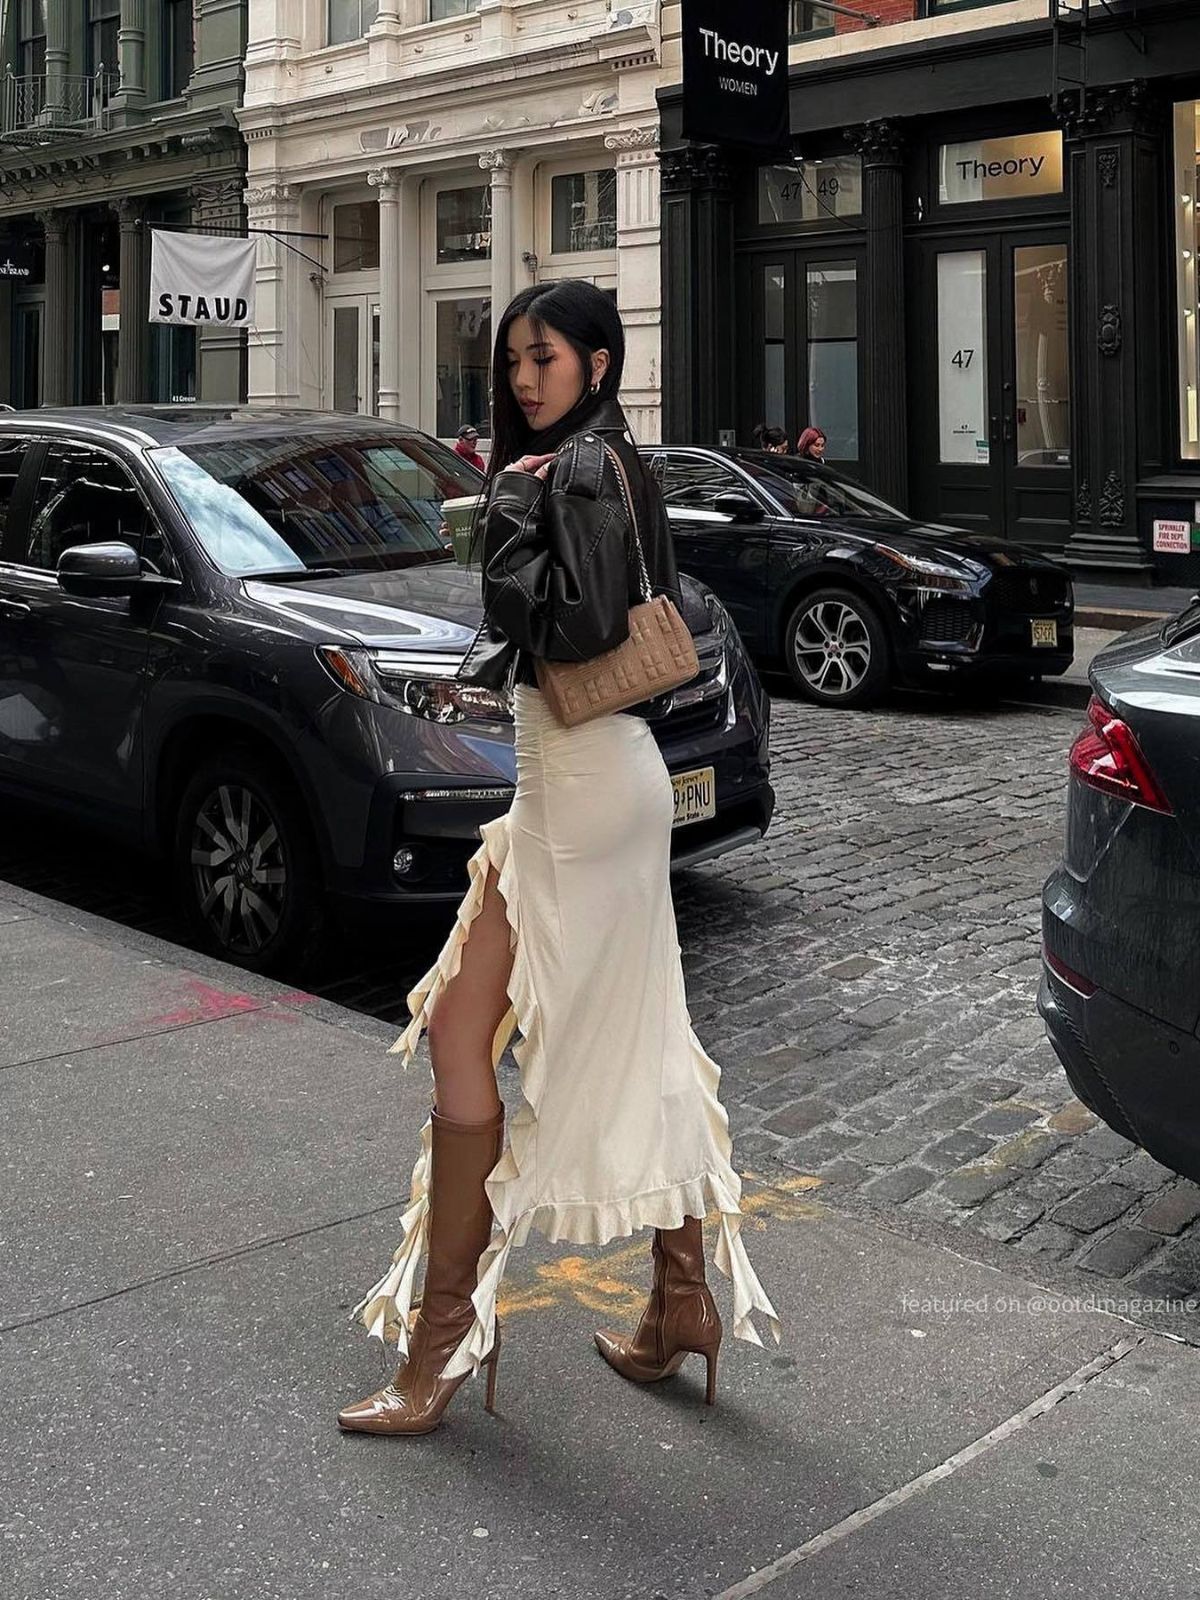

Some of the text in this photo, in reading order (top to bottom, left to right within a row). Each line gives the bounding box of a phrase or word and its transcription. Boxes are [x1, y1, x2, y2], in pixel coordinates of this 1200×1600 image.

[699, 27, 779, 75] Theory
[719, 76, 758, 96] WOMEN
[956, 156, 1045, 180] Theory
[781, 183, 801, 200] 47
[818, 178, 839, 196] 49
[159, 293, 248, 321] STAUD
[952, 349, 974, 368] 47
[1156, 541, 1188, 549] CONNECTION
[1159, 532, 1170, 540] FIRE
